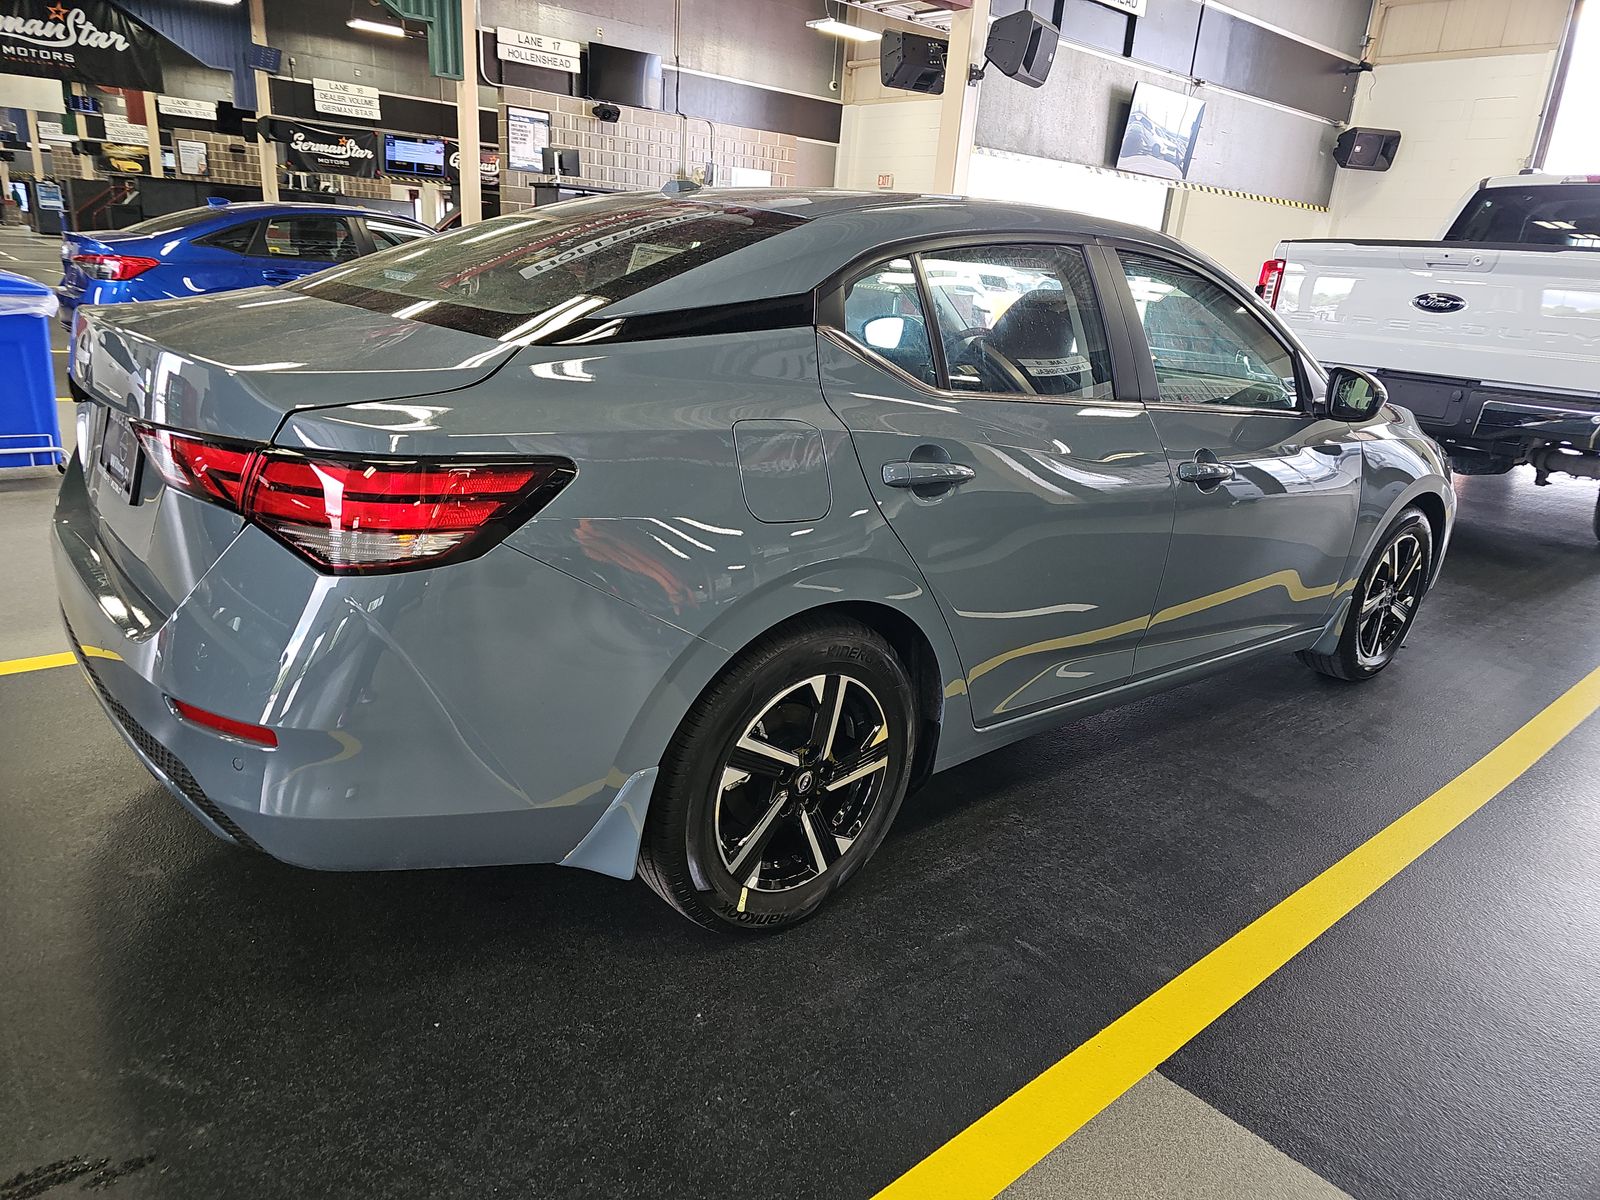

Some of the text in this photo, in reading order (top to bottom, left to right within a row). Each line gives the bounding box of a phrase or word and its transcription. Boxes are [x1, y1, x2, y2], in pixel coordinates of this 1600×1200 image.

[517, 34, 561, 51] LANE 17
[2, 45, 75, 63] MOTORS
[507, 48, 571, 69] HOLLENSHEAD
[328, 82, 349, 93] LANE
[320, 92, 375, 107] DEALER VOLUME
[321, 103, 374, 117] GERMAN STAR
[317, 157, 350, 166] MOTORS
[1290, 309, 1449, 333] SUPER
